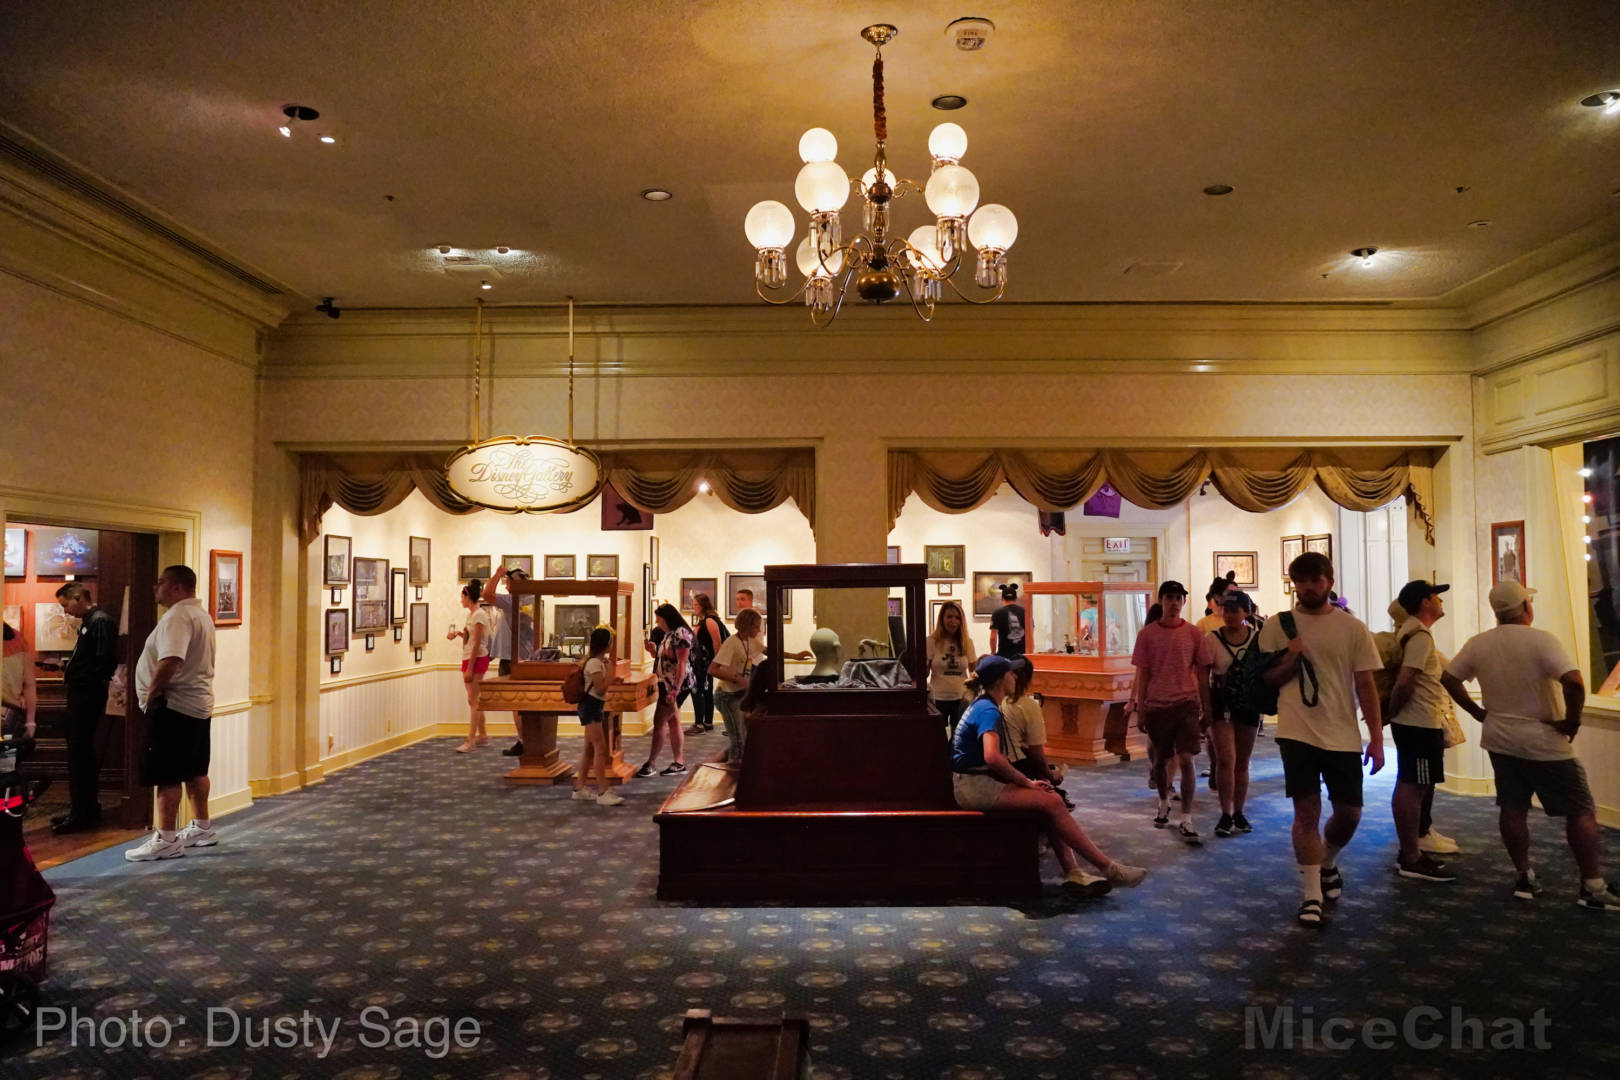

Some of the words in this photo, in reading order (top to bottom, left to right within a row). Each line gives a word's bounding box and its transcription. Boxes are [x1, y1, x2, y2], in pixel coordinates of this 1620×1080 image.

[468, 462, 523, 492] Disney
[521, 461, 575, 493] Gallery
[1106, 538, 1129, 549] EXIT
